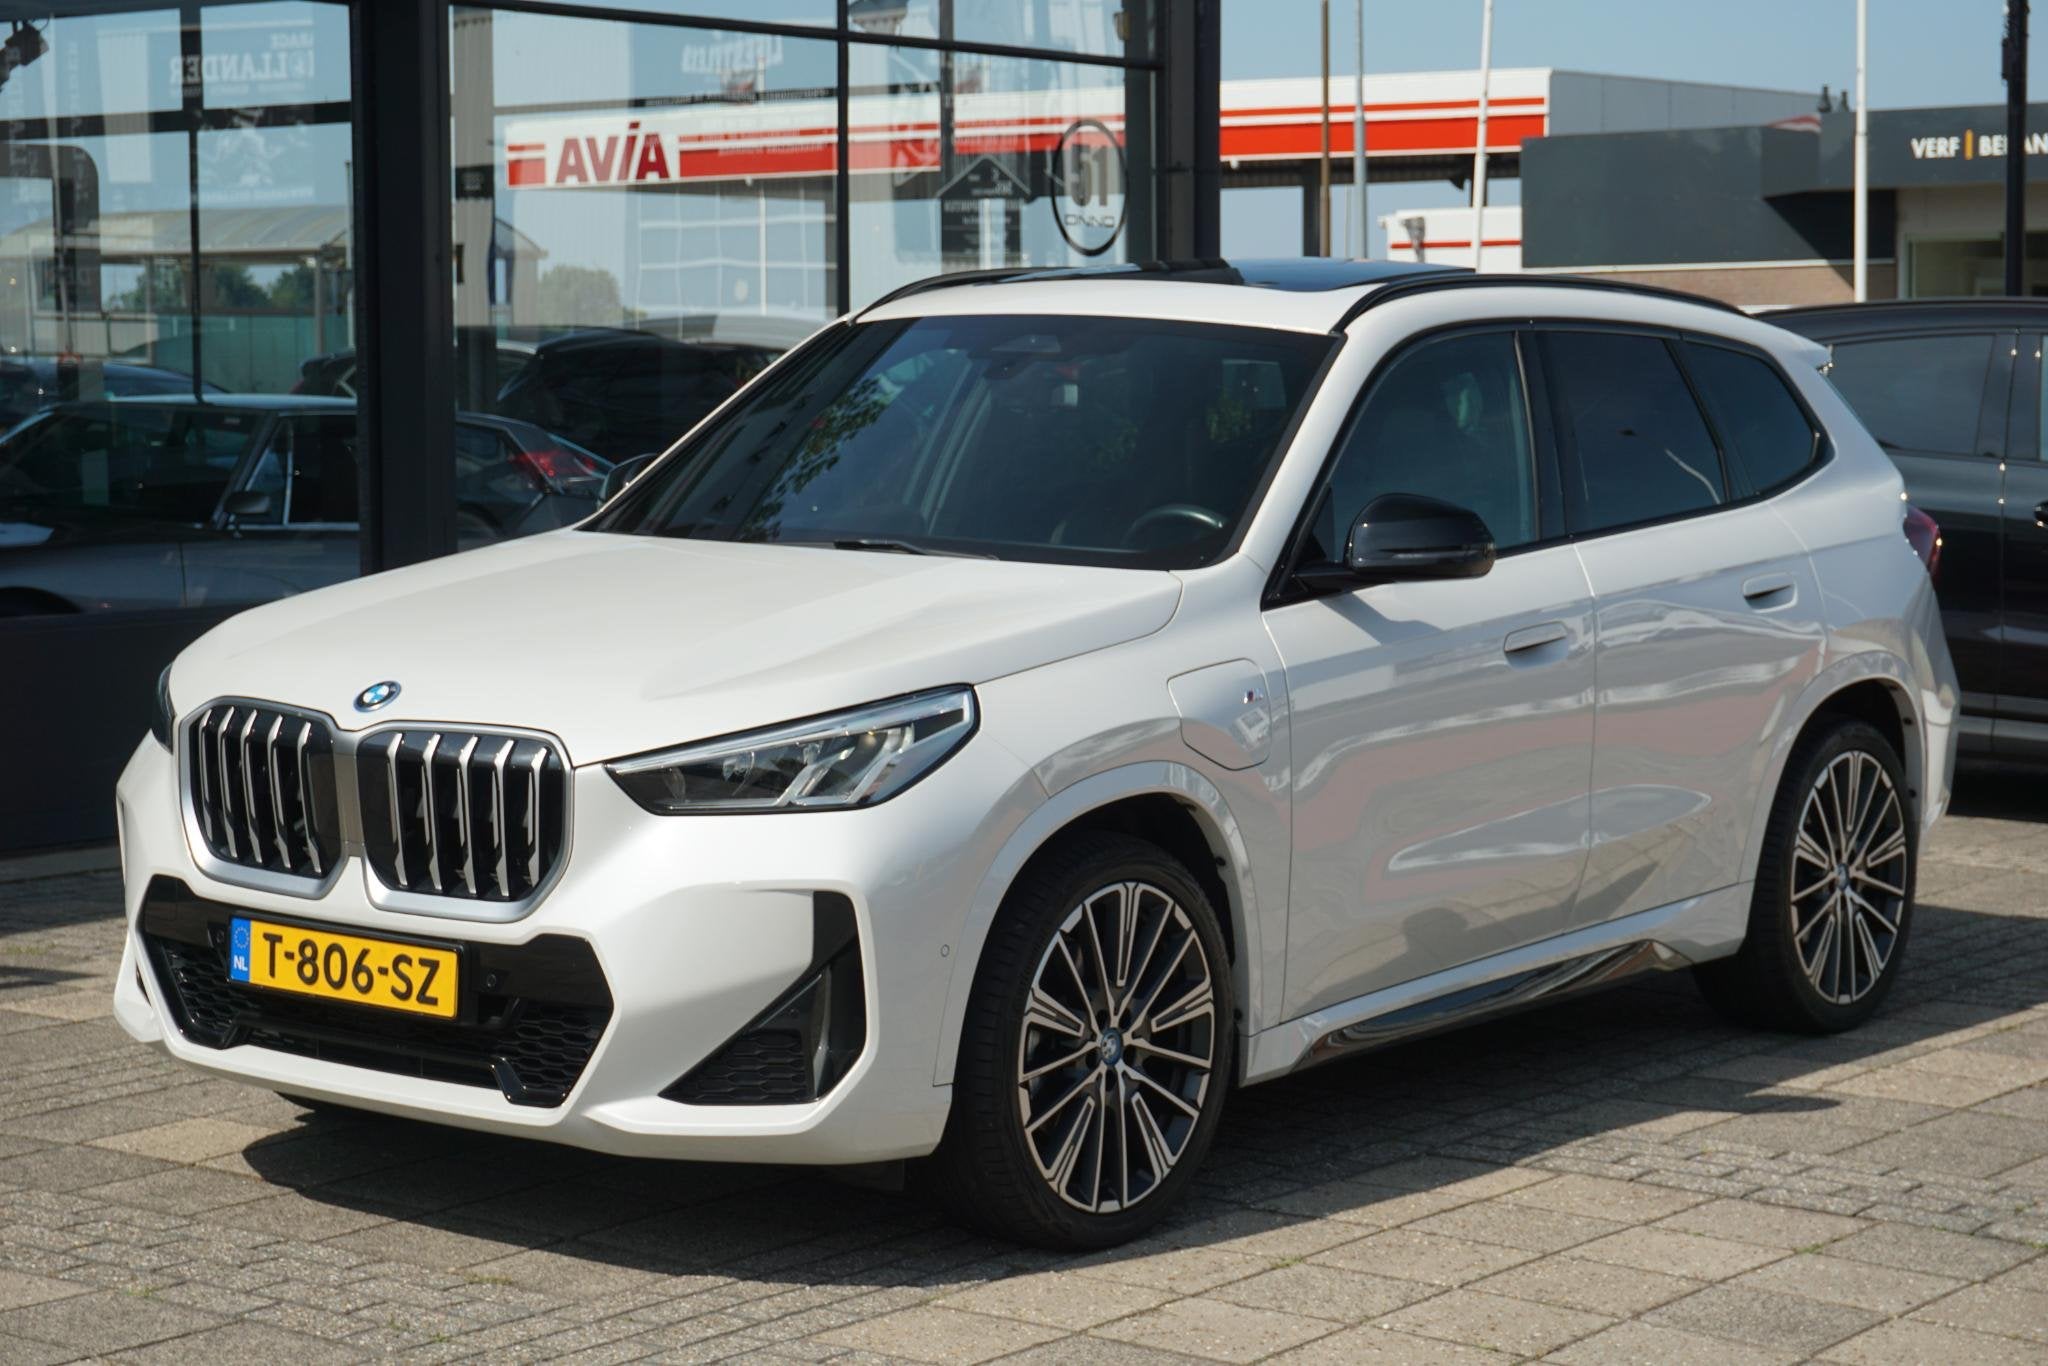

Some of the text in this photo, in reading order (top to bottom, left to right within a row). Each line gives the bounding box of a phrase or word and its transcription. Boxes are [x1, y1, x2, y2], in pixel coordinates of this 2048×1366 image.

[556, 121, 669, 183] AVIA
[1910, 133, 2048, 159] VERF BEAN
[234, 955, 248, 972] NL
[263, 932, 440, 1006] T-806-SZ
